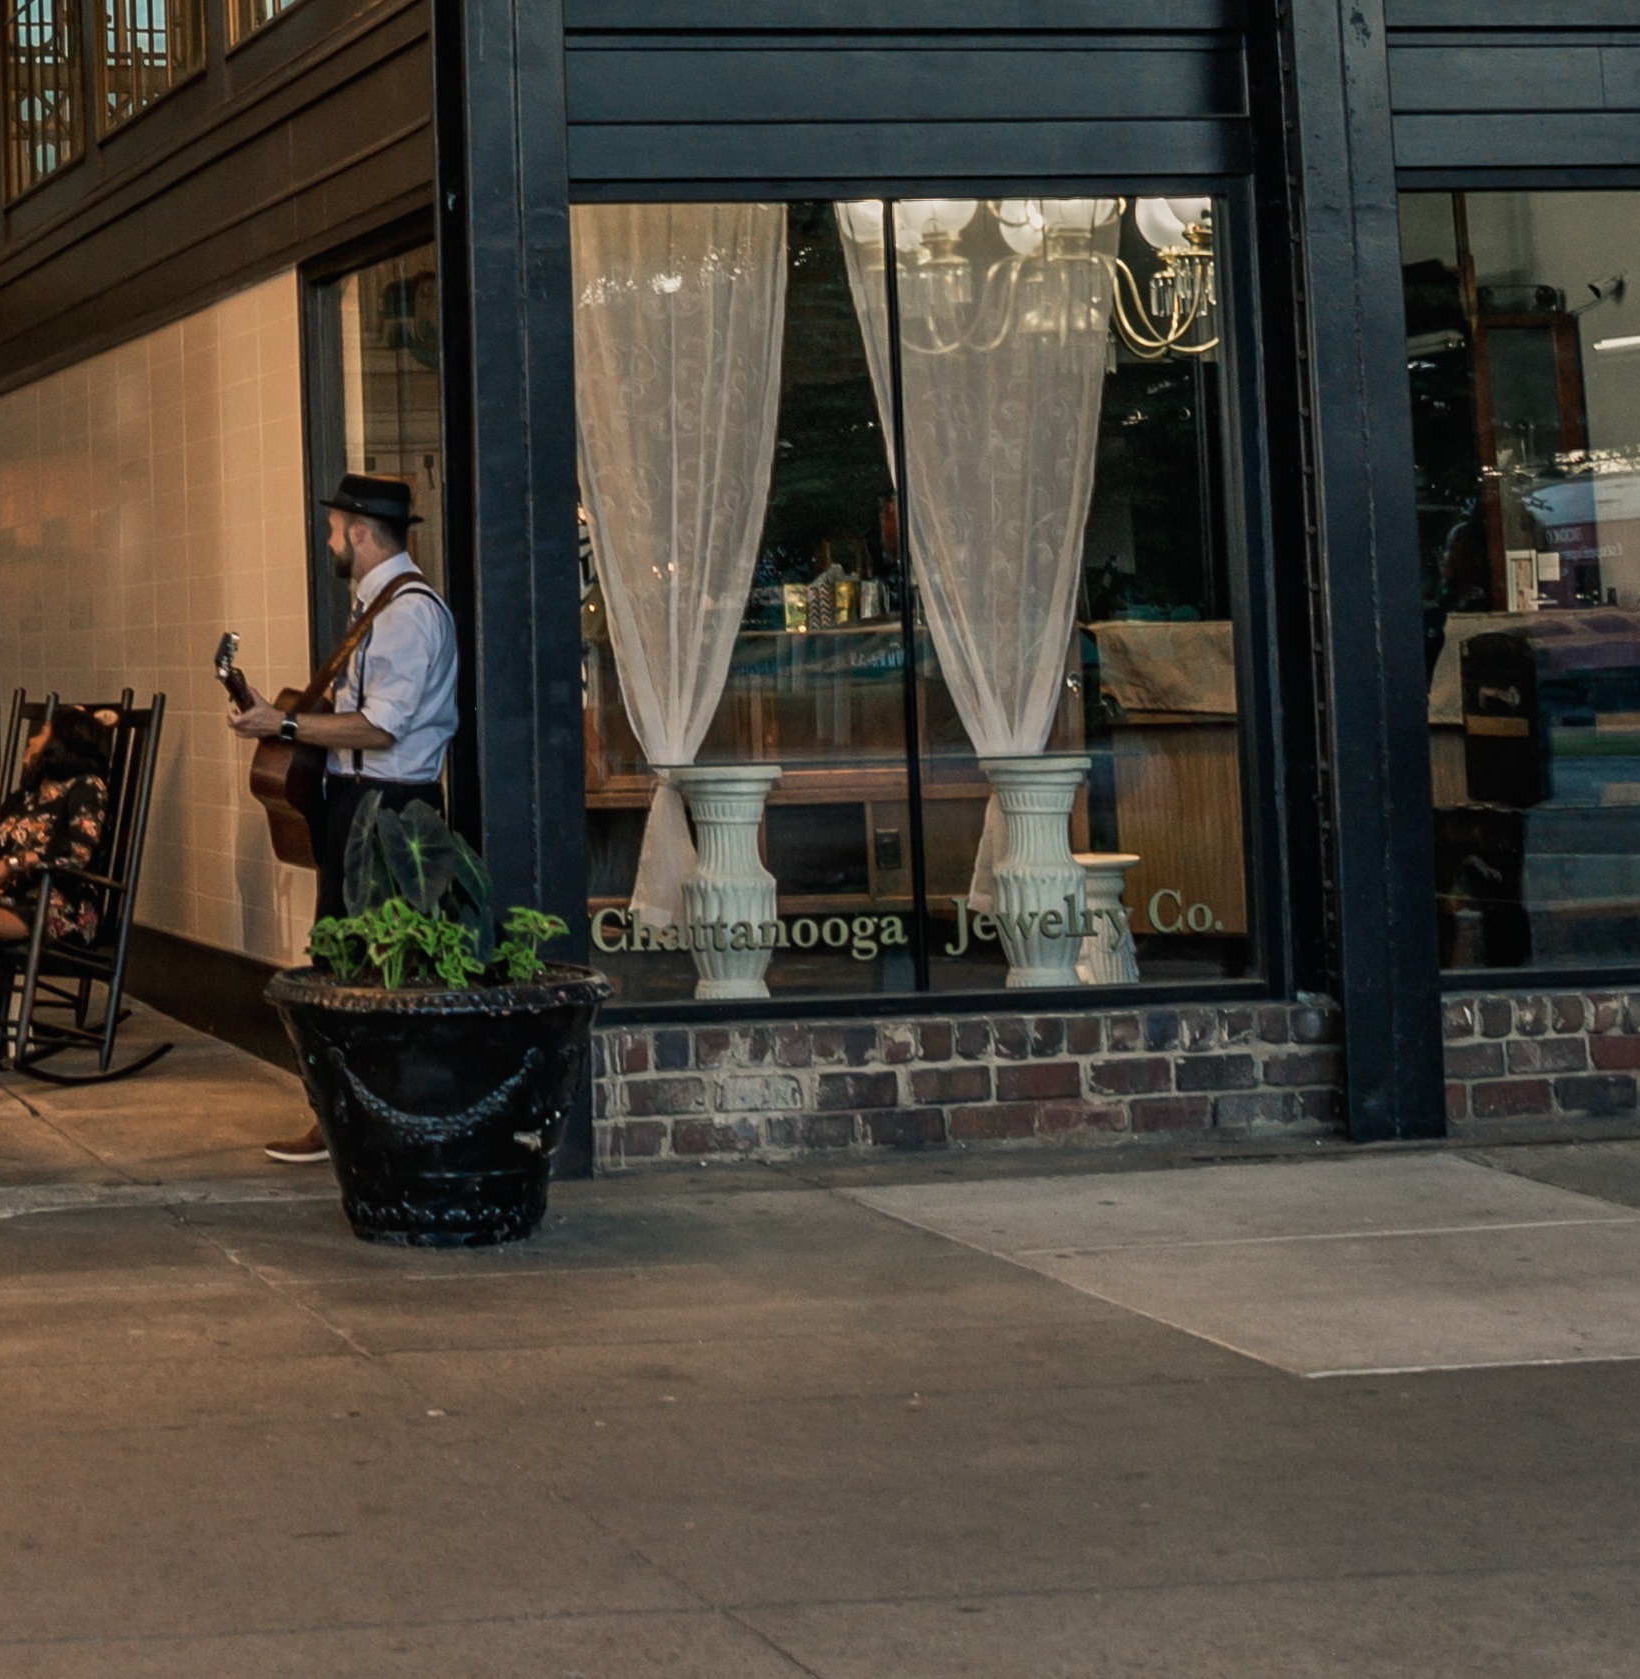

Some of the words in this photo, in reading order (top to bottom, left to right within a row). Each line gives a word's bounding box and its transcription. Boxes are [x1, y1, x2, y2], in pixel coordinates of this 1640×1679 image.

[590, 907, 908, 961] Chattanooga
[944, 893, 1134, 956] Jewelry
[1149, 888, 1224, 934] Co.
